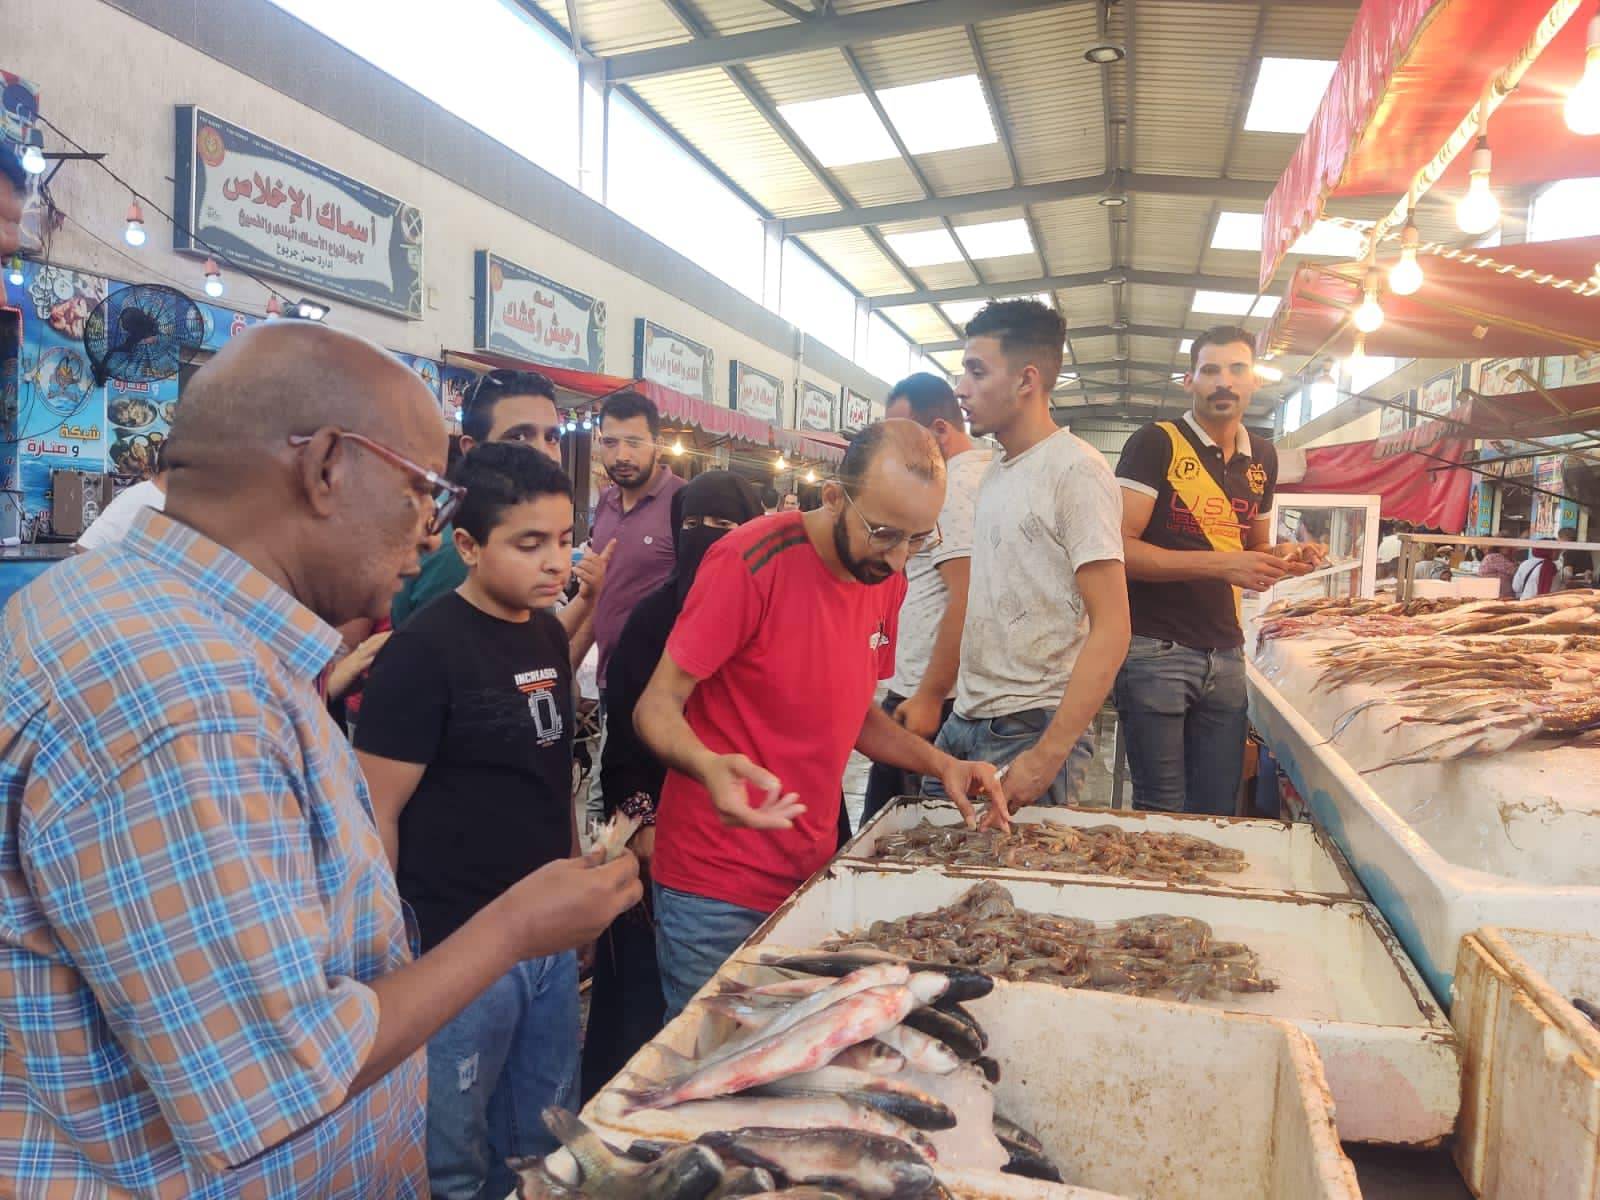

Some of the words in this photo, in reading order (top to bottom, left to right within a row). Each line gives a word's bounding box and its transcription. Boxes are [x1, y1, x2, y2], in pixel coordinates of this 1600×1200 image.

[223, 171, 312, 224] الإخلاص
[59, 423, 101, 443] شبكة
[27, 439, 68, 457] صنارة
[1170, 491, 1258, 519] USPA
